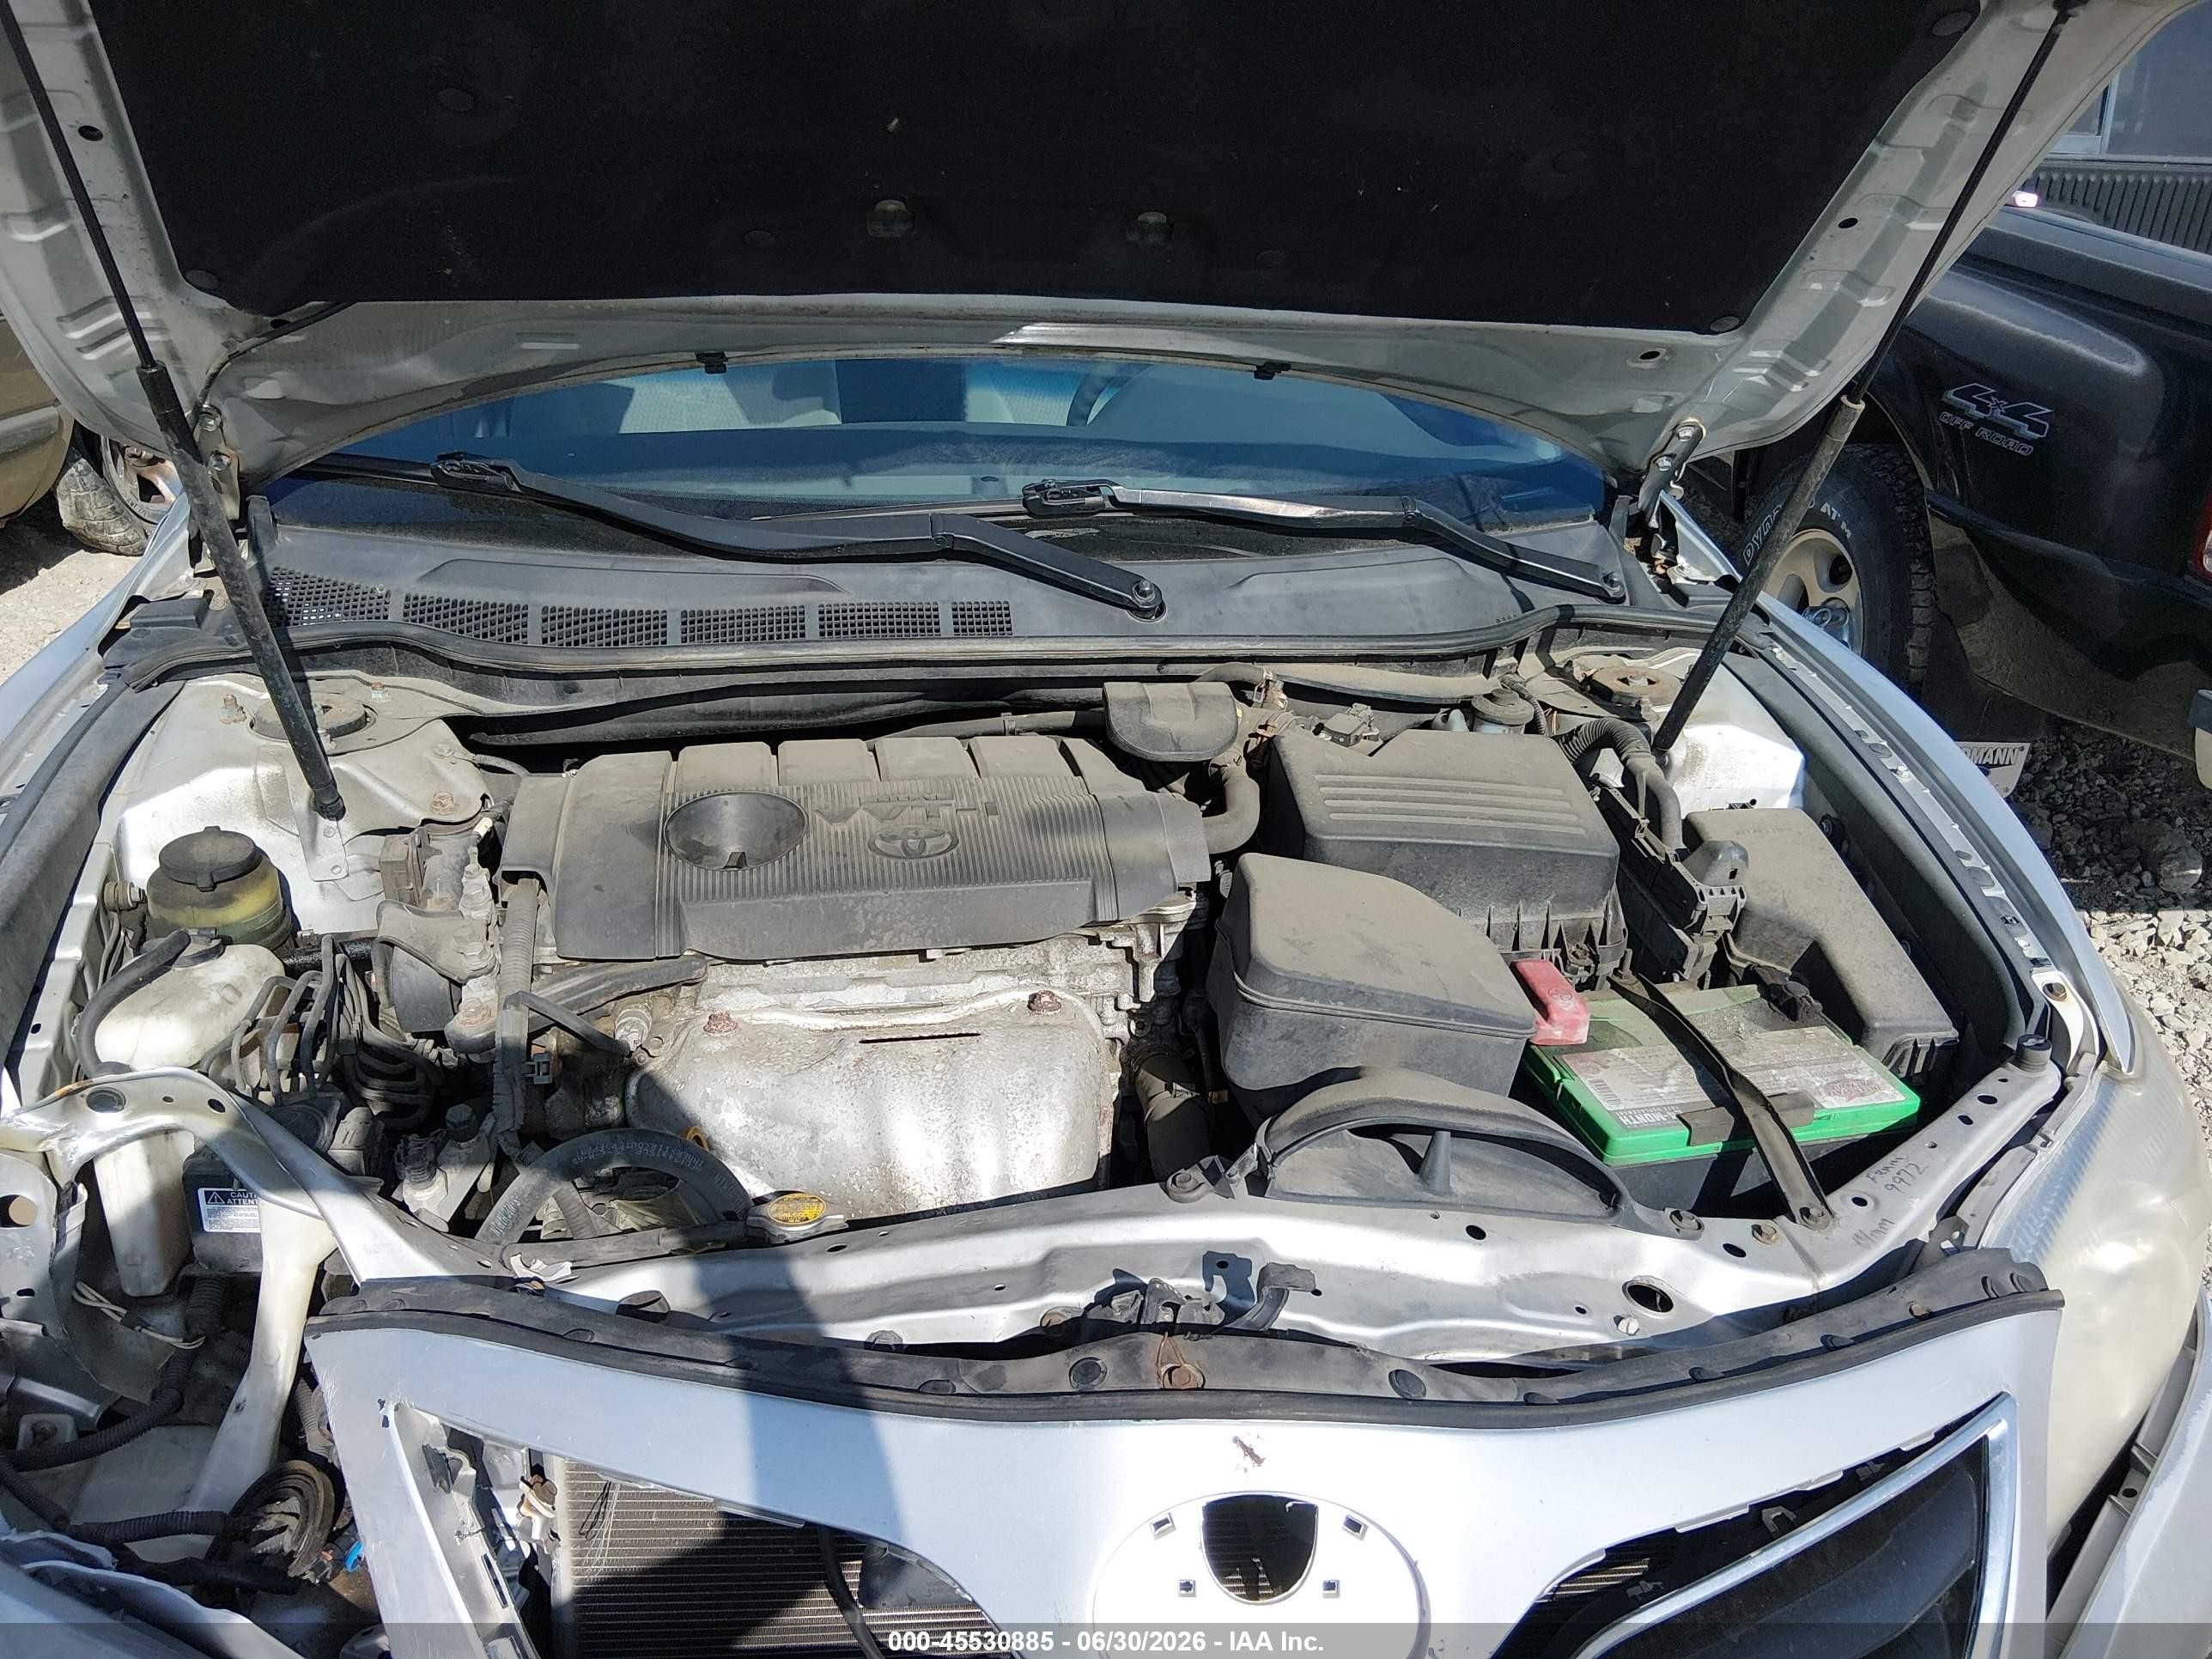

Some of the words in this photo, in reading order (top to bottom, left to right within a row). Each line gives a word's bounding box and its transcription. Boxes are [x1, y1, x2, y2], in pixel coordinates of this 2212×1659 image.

[1939, 411, 1975, 430] OFF
[1975, 427, 2034, 456] ROAD
[1884, 1163, 1930, 1194] 9972
